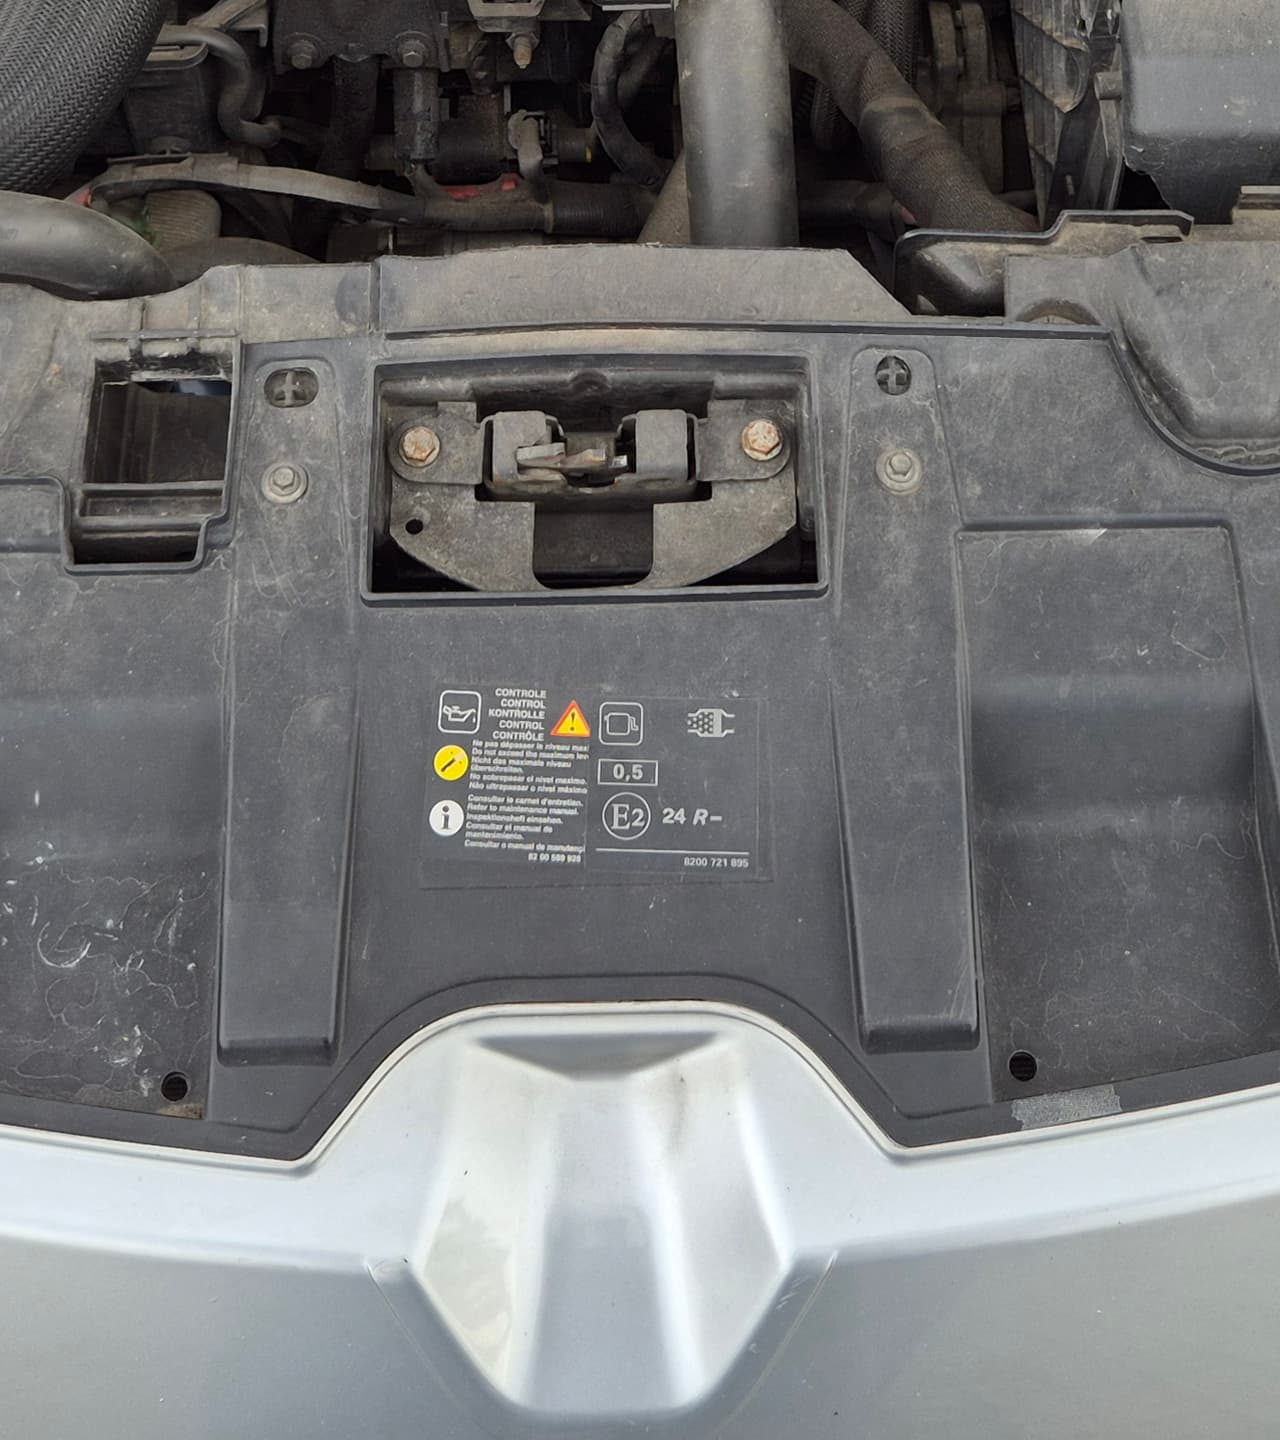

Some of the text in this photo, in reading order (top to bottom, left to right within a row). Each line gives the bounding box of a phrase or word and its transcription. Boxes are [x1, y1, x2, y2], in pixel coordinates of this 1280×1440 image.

[495, 688, 547, 698] CONTROLE
[501, 698, 546, 709] CONTROL
[488, 708, 545, 719] KONTROLLE
[499, 719, 545, 730] CONTROL
[492, 730, 544, 741] CONTRÔLE
[612, 763, 644, 782] 0,5
[466, 802, 488, 811] Refer
[489, 803, 497, 811] to
[610, 803, 646, 830] E2
[662, 807, 687, 825] 24
[683, 856, 708, 867] 8200
[710, 857, 728, 868] 721
